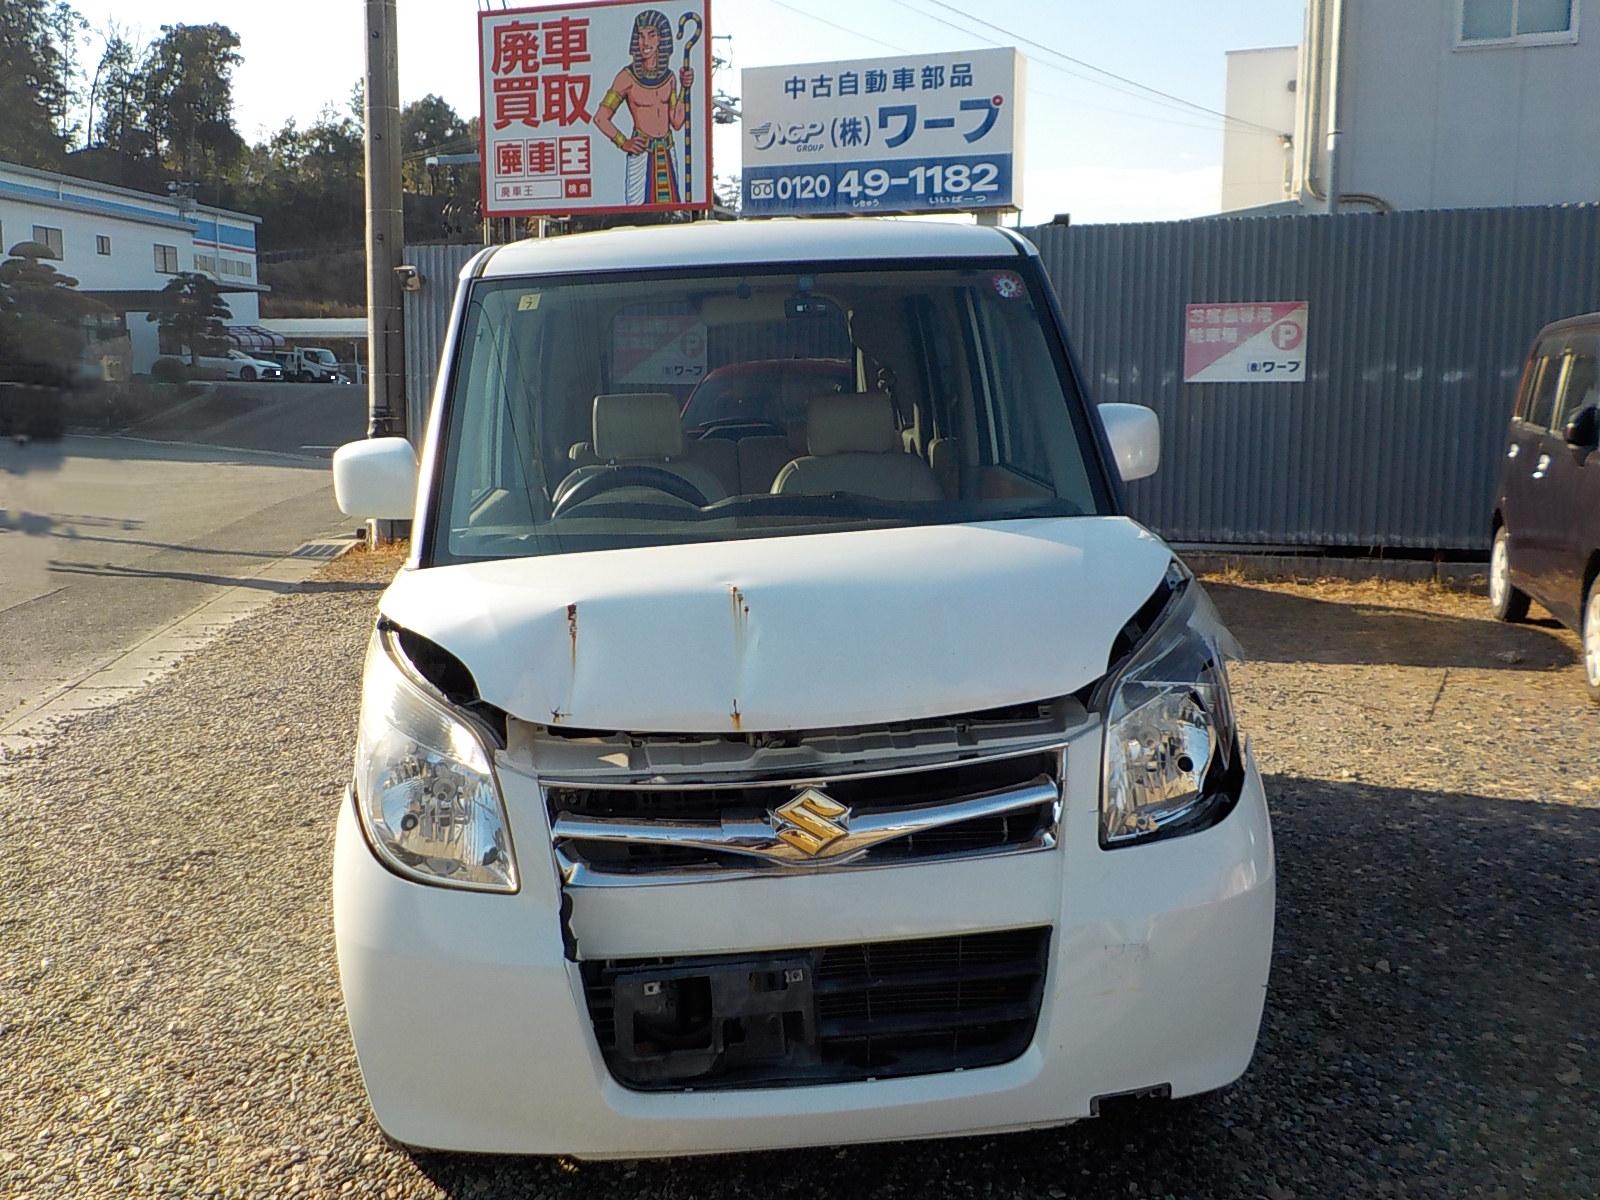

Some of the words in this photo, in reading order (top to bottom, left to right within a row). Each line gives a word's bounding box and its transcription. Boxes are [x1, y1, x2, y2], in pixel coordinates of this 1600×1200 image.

[491, 17, 591, 75] 廃車
[784, 64, 974, 100] 中古自動車部品
[493, 74, 592, 130] 買取
[796, 143, 825, 153] GROUP
[777, 174, 831, 199] 0120
[837, 163, 999, 197] 49-1182
